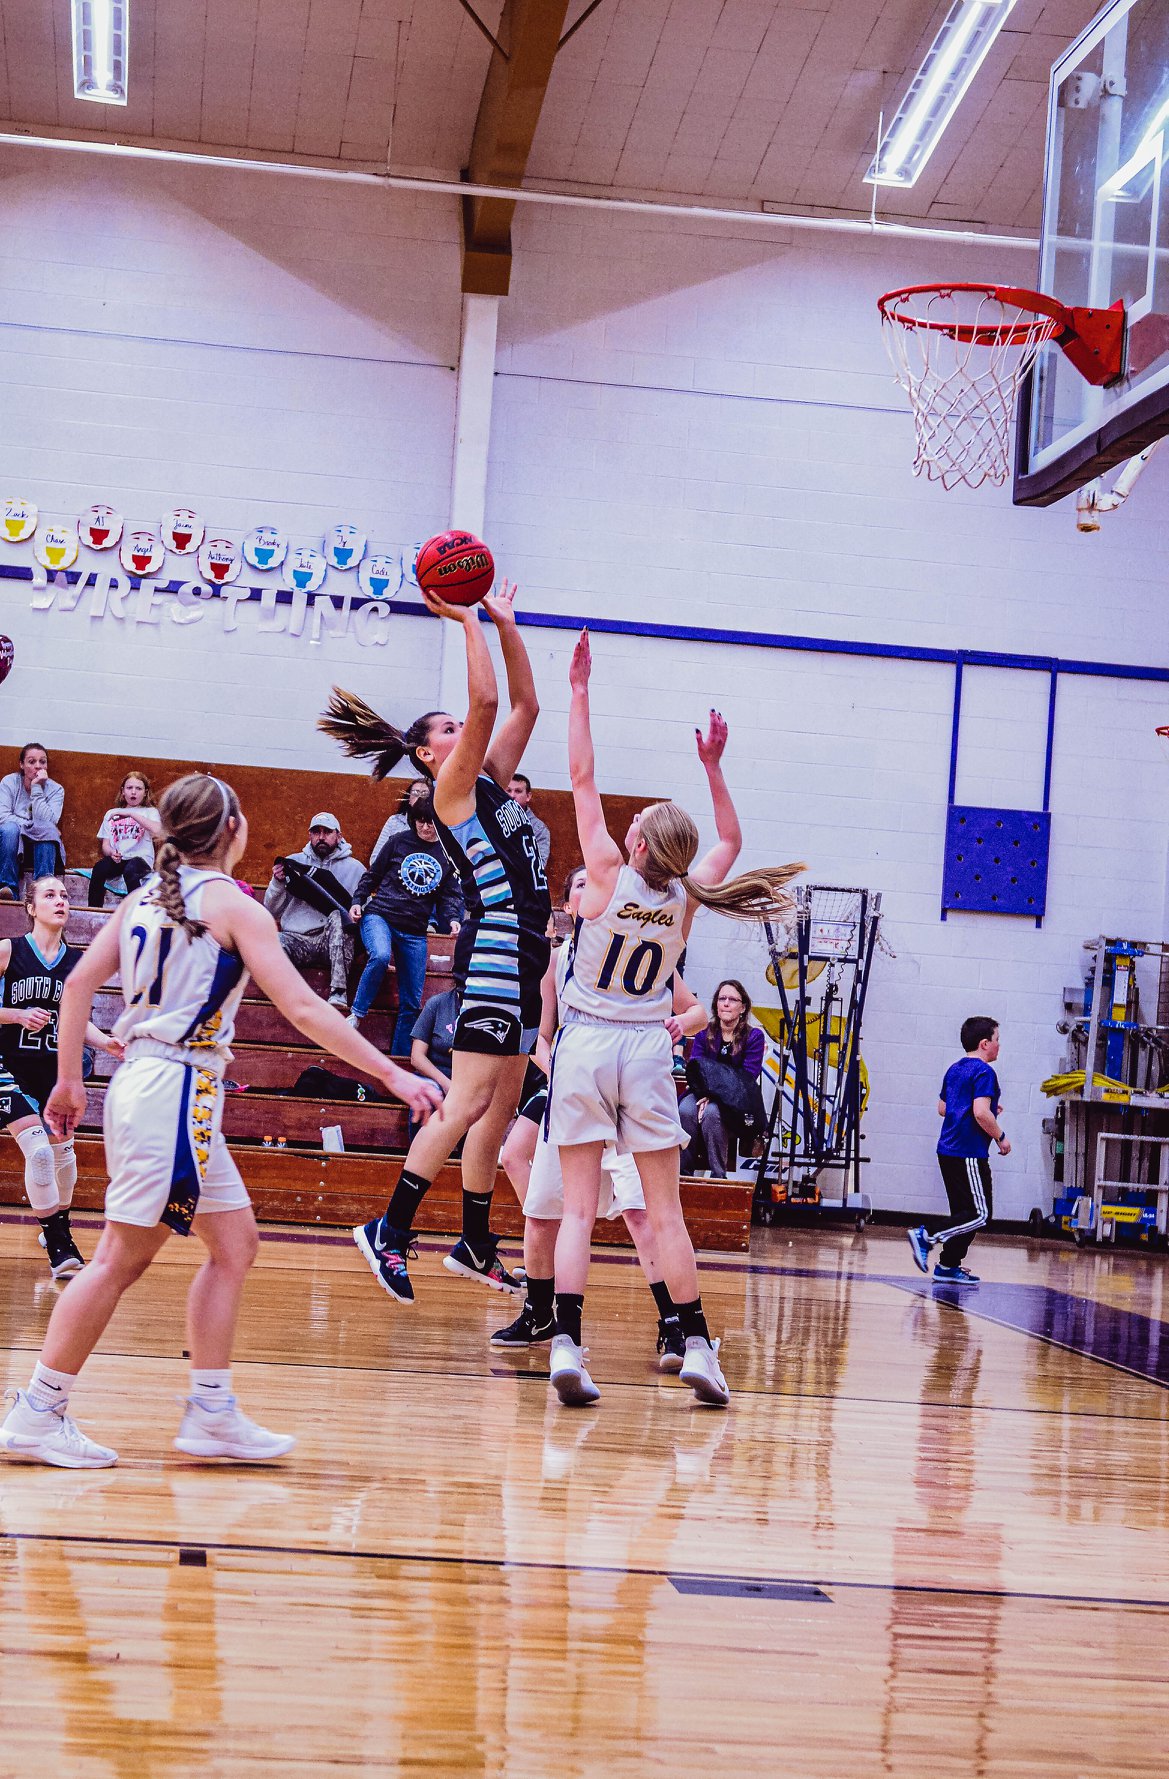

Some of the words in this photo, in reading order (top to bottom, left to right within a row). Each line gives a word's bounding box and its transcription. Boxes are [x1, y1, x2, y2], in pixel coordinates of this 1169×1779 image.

[436, 552, 490, 578] Wilson
[31, 566, 392, 648] WRESTLING
[616, 902, 675, 928] Eagles
[594, 928, 666, 999] 10
[11, 976, 52, 1005] SOUTH
